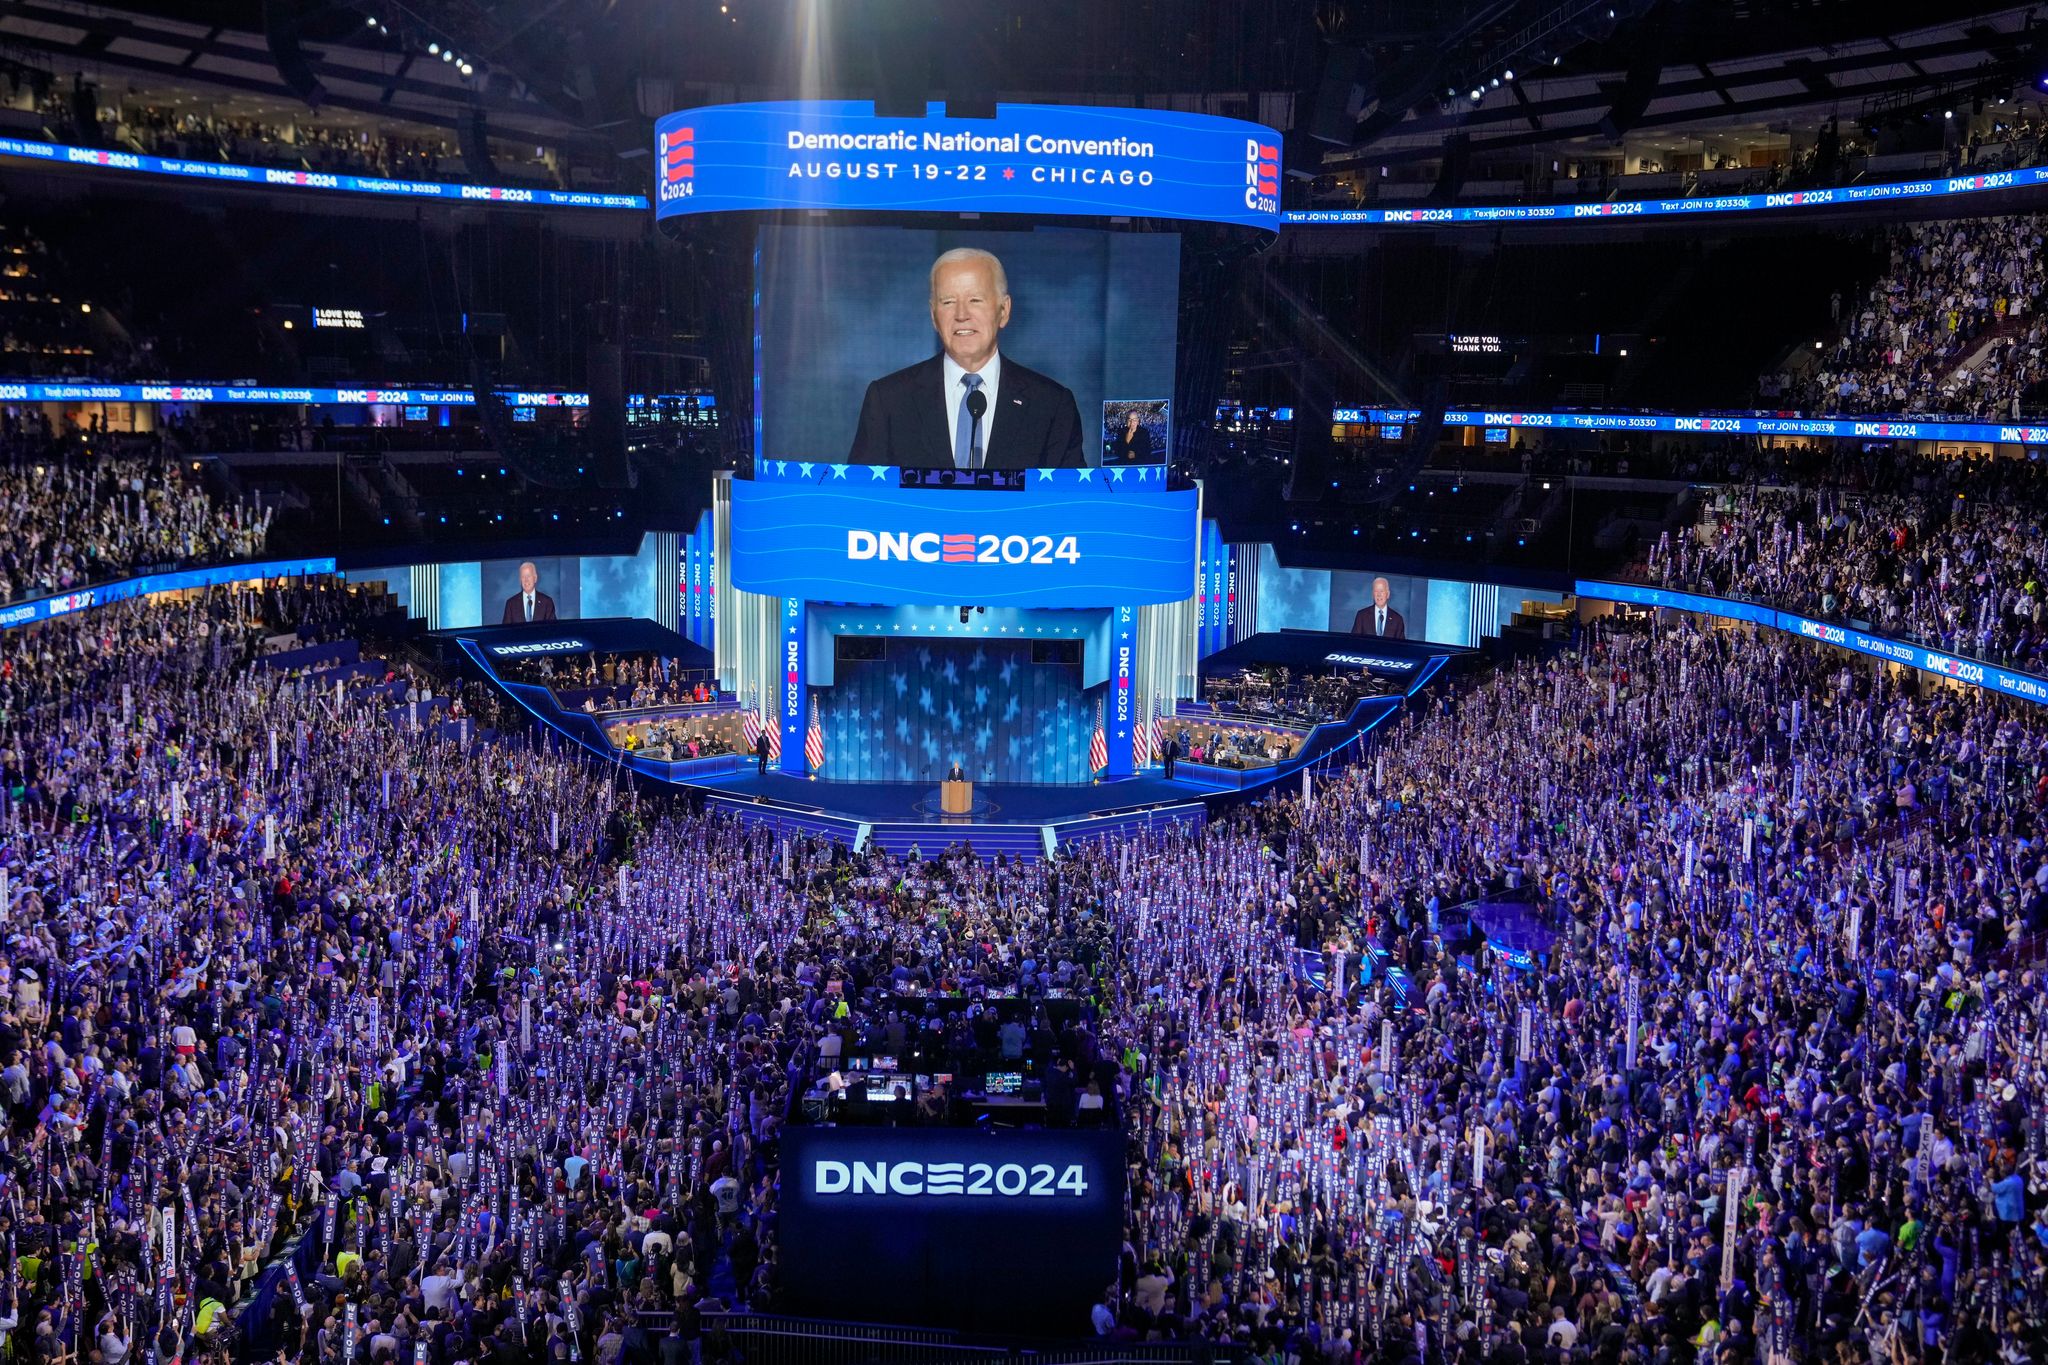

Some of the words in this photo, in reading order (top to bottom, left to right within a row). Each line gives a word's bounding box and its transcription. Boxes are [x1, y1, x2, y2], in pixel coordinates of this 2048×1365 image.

[788, 130, 917, 150] Democratic
[923, 132, 1019, 153] National
[1026, 135, 1154, 157] Convention
[68, 148, 98, 164] DNC
[108, 153, 139, 168] 2024
[182, 162, 206, 173] JOIN
[208, 165, 216, 174] to
[660, 132, 668, 200] DNC
[266, 169, 296, 183] DNC
[305, 174, 337, 187] 2024
[788, 162, 898, 178] AUGUST
[913, 164, 986, 180] 19-22
[1032, 167, 1153, 185] CHICAGO
[1246, 139, 1258, 209] DNC
[401, 183, 410, 192] to
[412, 184, 441, 194] 30330
[1949, 178, 1975, 192] DNC
[1983, 173, 2013, 187] 2024
[462, 186, 491, 198] DNC
[501, 189, 532, 201] 2024
[668, 182, 693, 200] 2024
[1849, 189, 1867, 198] Text
[1868, 187, 1890, 196] JOIN
[1903, 184, 1932, 194] 30330
[550, 194, 567, 202] Text
[569, 194, 590, 203] JOIN
[1258, 197, 1276, 214] 2024
[1661, 202, 1679, 210] Text
[1680, 201, 1702, 209] JOIN
[1715, 199, 1744, 208] 30330
[1766, 194, 1792, 207] DNC
[1802, 192, 1832, 203] 2024
[1288, 213, 1305, 221] Text
[1307, 213, 1328, 221] JOIN
[1330, 213, 1338, 221] to
[1341, 213, 1367, 221] 30330
[1385, 211, 1412, 221] DNC
[1422, 210, 1452, 220] 2024
[1493, 209, 1514, 217] JOIN
[1517, 209, 1526, 217] to
[1528, 208, 1555, 216] 30330
[1575, 206, 1601, 216] DNC
[1611, 204, 1642, 214] 2024
[316, 309, 319, 317] I
[320, 309, 342, 318] LOVE
[343, 310, 363, 319] YOU.
[316, 318, 344, 327] THANK
[344, 319, 364, 328] YOU.
[82, 388, 90, 397] to
[91, 388, 121, 398] 30330
[142, 387, 172, 400] DNC
[182, 388, 213, 400] 2024
[228, 390, 245, 399] Text
[247, 391, 268, 399] JOIN
[270, 391, 279, 400] to
[281, 390, 310, 400] 30330
[337, 390, 367, 402] DNC
[376, 391, 409, 402] 2024
[420, 393, 438, 402] Text
[440, 393, 463, 402] JOIN
[465, 394, 475, 402] to
[518, 394, 548, 405] DNC
[1485, 414, 1512, 424] DNC
[1521, 414, 1552, 425] 2024
[1594, 417, 1615, 426] JOIN
[1618, 418, 1627, 426] to
[1628, 418, 1656, 427] 30330
[1675, 418, 1702, 430] DNC
[1710, 420, 1741, 431] 2024
[1757, 422, 1775, 430] Text
[1777, 422, 1799, 431] JOIN
[1800, 423, 1809, 432] to
[1855, 423, 1880, 435] DNC
[1888, 424, 1916, 436] 2024
[2001, 428, 2021, 441] DNC
[848, 531, 940, 562] DNC
[977, 534, 1080, 564] 2024
[50, 596, 70, 614] DNC
[1802, 620, 1820, 638] DNC
[1825, 626, 1845, 643] 2024
[493, 644, 532, 654] DNC
[541, 641, 583, 651] 2024
[1857, 636, 1868, 647] Text
[1869, 640, 1884, 652] JOIN
[1886, 643, 1892, 654] to
[1893, 644, 1913, 660] 30330
[788, 641, 798, 672] DNC
[1119, 647, 1130, 678] DNC
[1324, 653, 1362, 664] DNC
[1371, 659, 1413, 669] 2024
[1927, 653, 1950, 674] DNC
[1957, 662, 1983, 683] 2024
[1999, 674, 2015, 689] Text
[2016, 678, 2036, 695] JOIN
[2038, 685, 2046, 698] to
[788, 684, 798, 716] 2024
[1118, 689, 1128, 722] 2024
[467, 1124, 474, 1136] WE
[1919, 1123, 1931, 1171] TEXAS
[816, 1160, 923, 1195] DNC
[967, 1163, 1088, 1196] 2024
[328, 1195, 337, 1208] WE
[1667, 1193, 1675, 1210] WE
[346, 1305, 355, 1320] WE
[1484, 1310, 1491, 1324] WE
